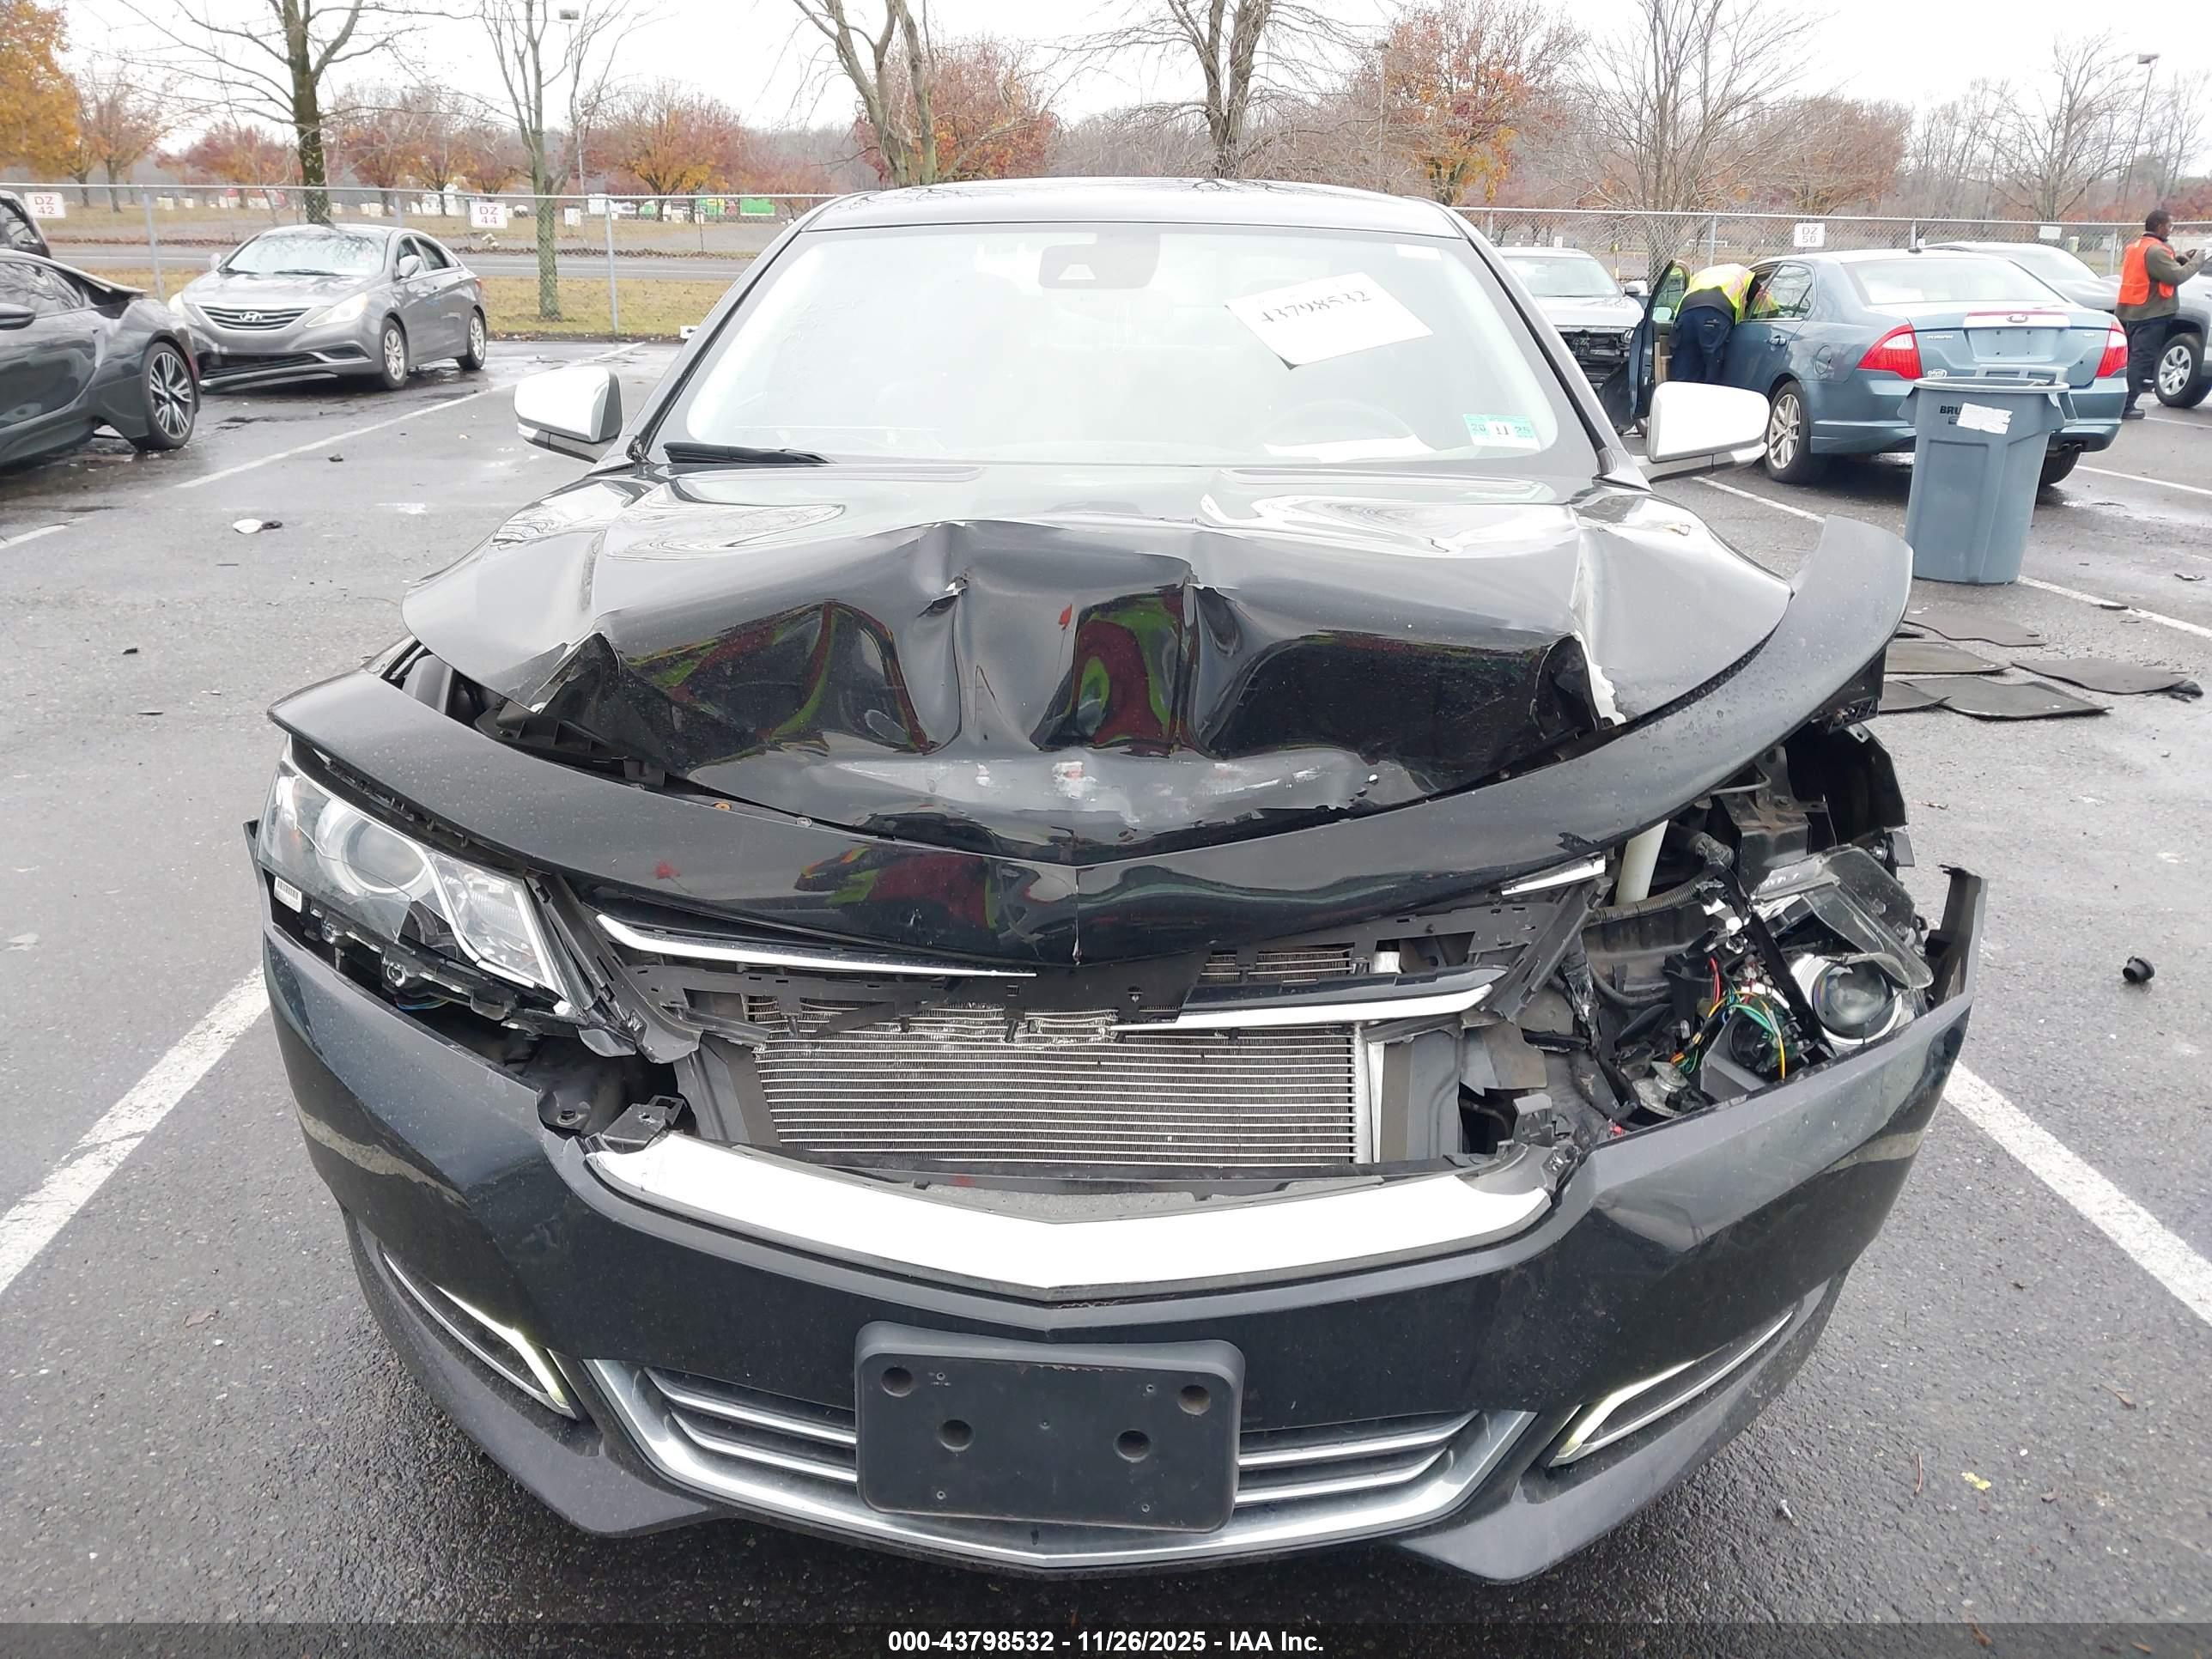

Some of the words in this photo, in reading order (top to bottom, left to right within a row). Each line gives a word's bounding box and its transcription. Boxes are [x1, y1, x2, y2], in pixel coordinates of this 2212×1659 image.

[33, 196, 55, 205] DZ
[38, 206, 56, 215] 42
[479, 205, 499, 215] DZ
[480, 216, 497, 224] 44
[1802, 226, 1818, 235] DZ
[1802, 235, 1817, 244] 50
[1261, 289, 1372, 324] 43798532
[1939, 405, 1962, 416] BRU
